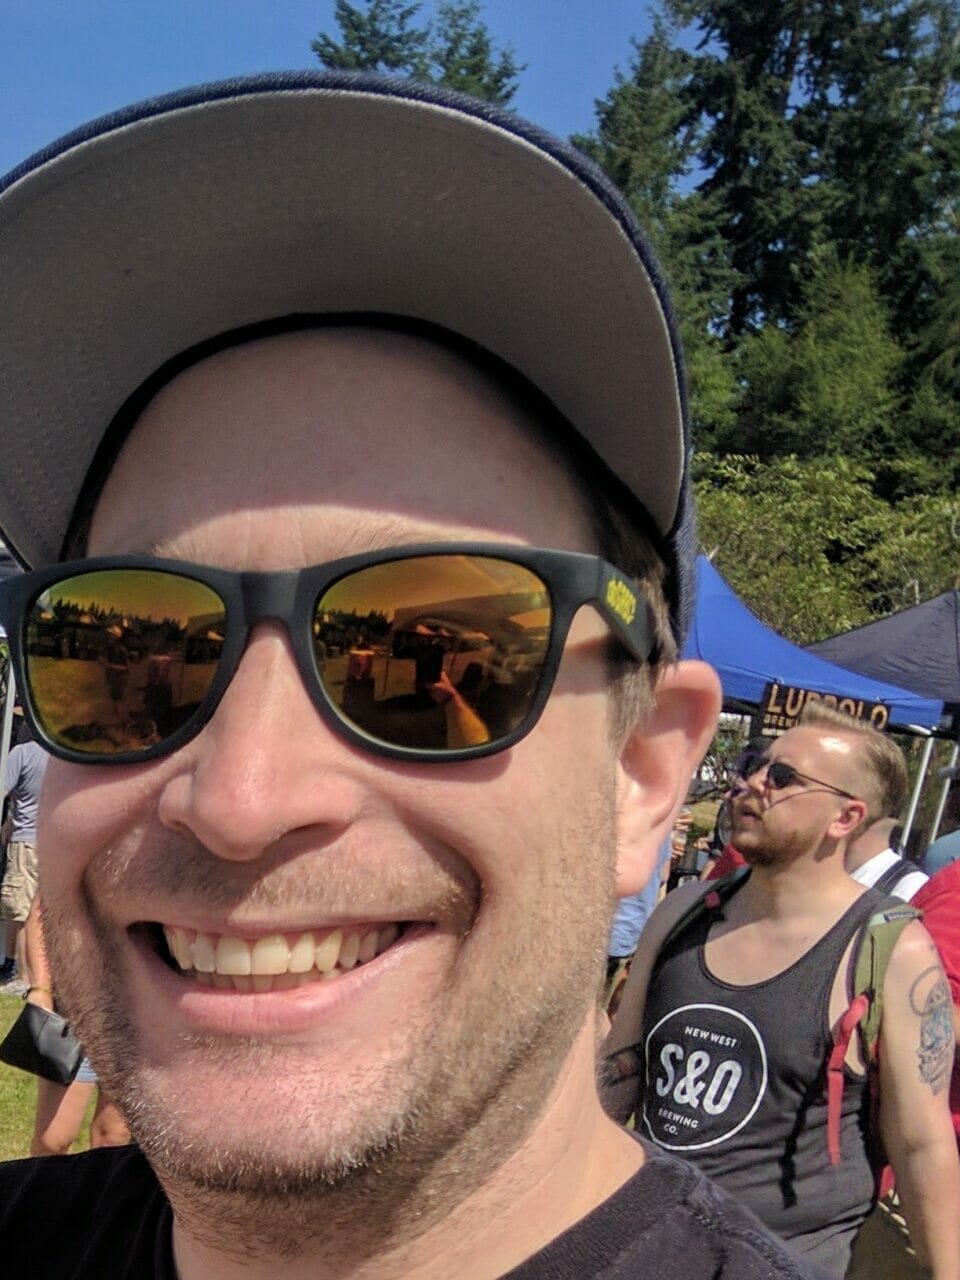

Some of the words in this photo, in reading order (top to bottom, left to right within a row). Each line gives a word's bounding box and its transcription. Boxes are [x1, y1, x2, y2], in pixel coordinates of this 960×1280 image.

[684, 1026, 710, 1040] NEW
[711, 1032, 737, 1048] WEST
[656, 1043, 742, 1115] S&O
[658, 1108, 699, 1128] BREWING
[664, 1123, 679, 1135] CO.
